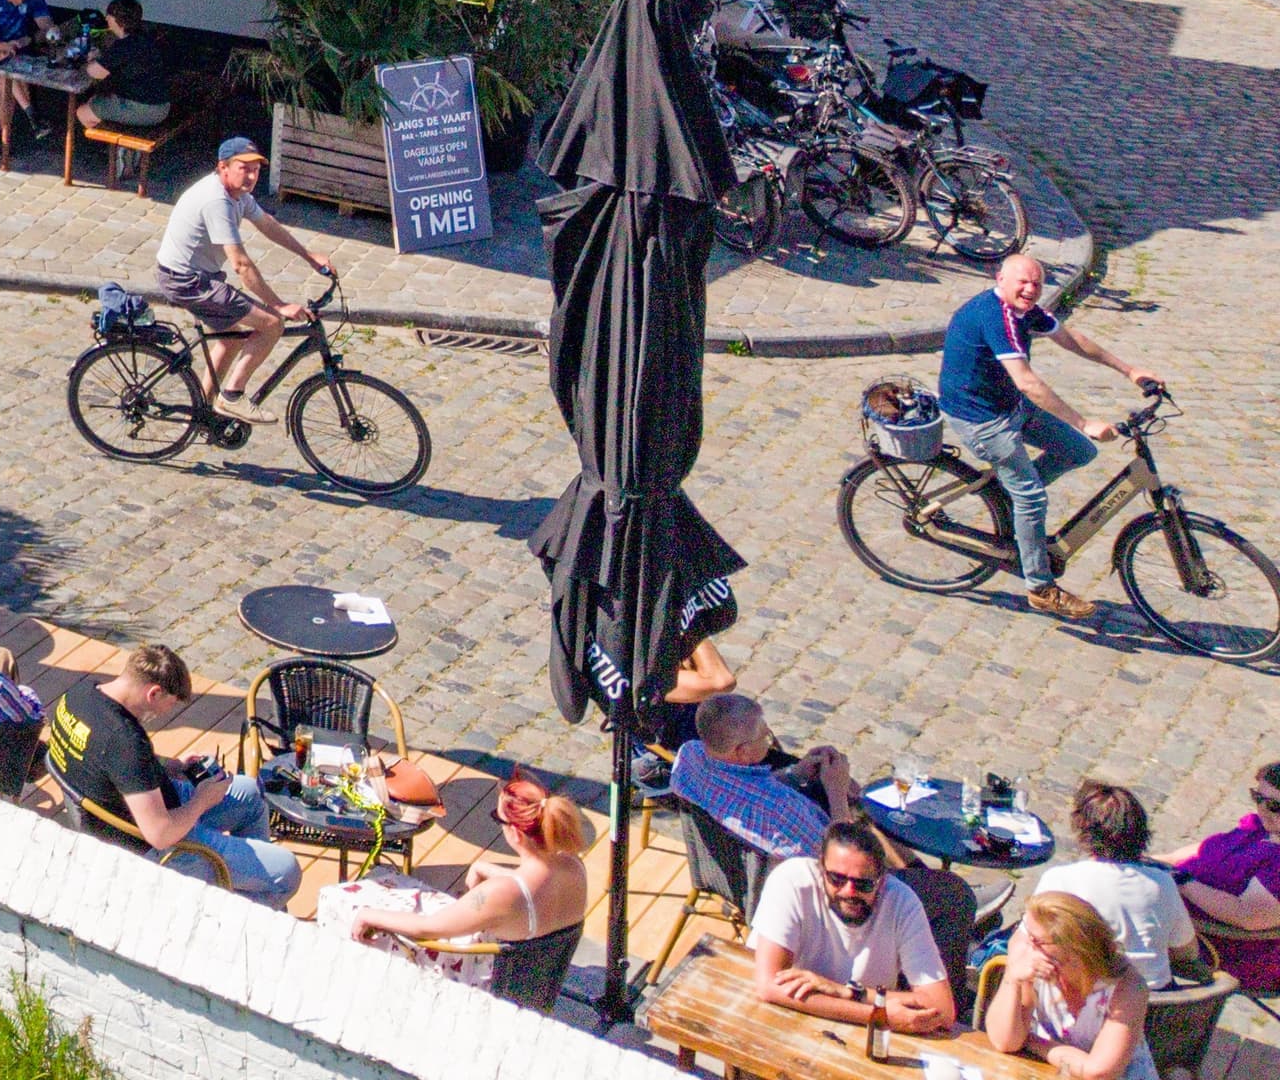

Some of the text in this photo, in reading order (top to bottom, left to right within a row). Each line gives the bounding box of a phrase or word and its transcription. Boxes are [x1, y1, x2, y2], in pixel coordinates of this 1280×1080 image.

[393, 111, 472, 132] LANGS DE VAART
[403, 140, 468, 159] DAGELIJKS OPEN
[418, 154, 445, 167] VANAF
[409, 188, 473, 212] OPENING
[410, 207, 476, 239] 1 MEI
